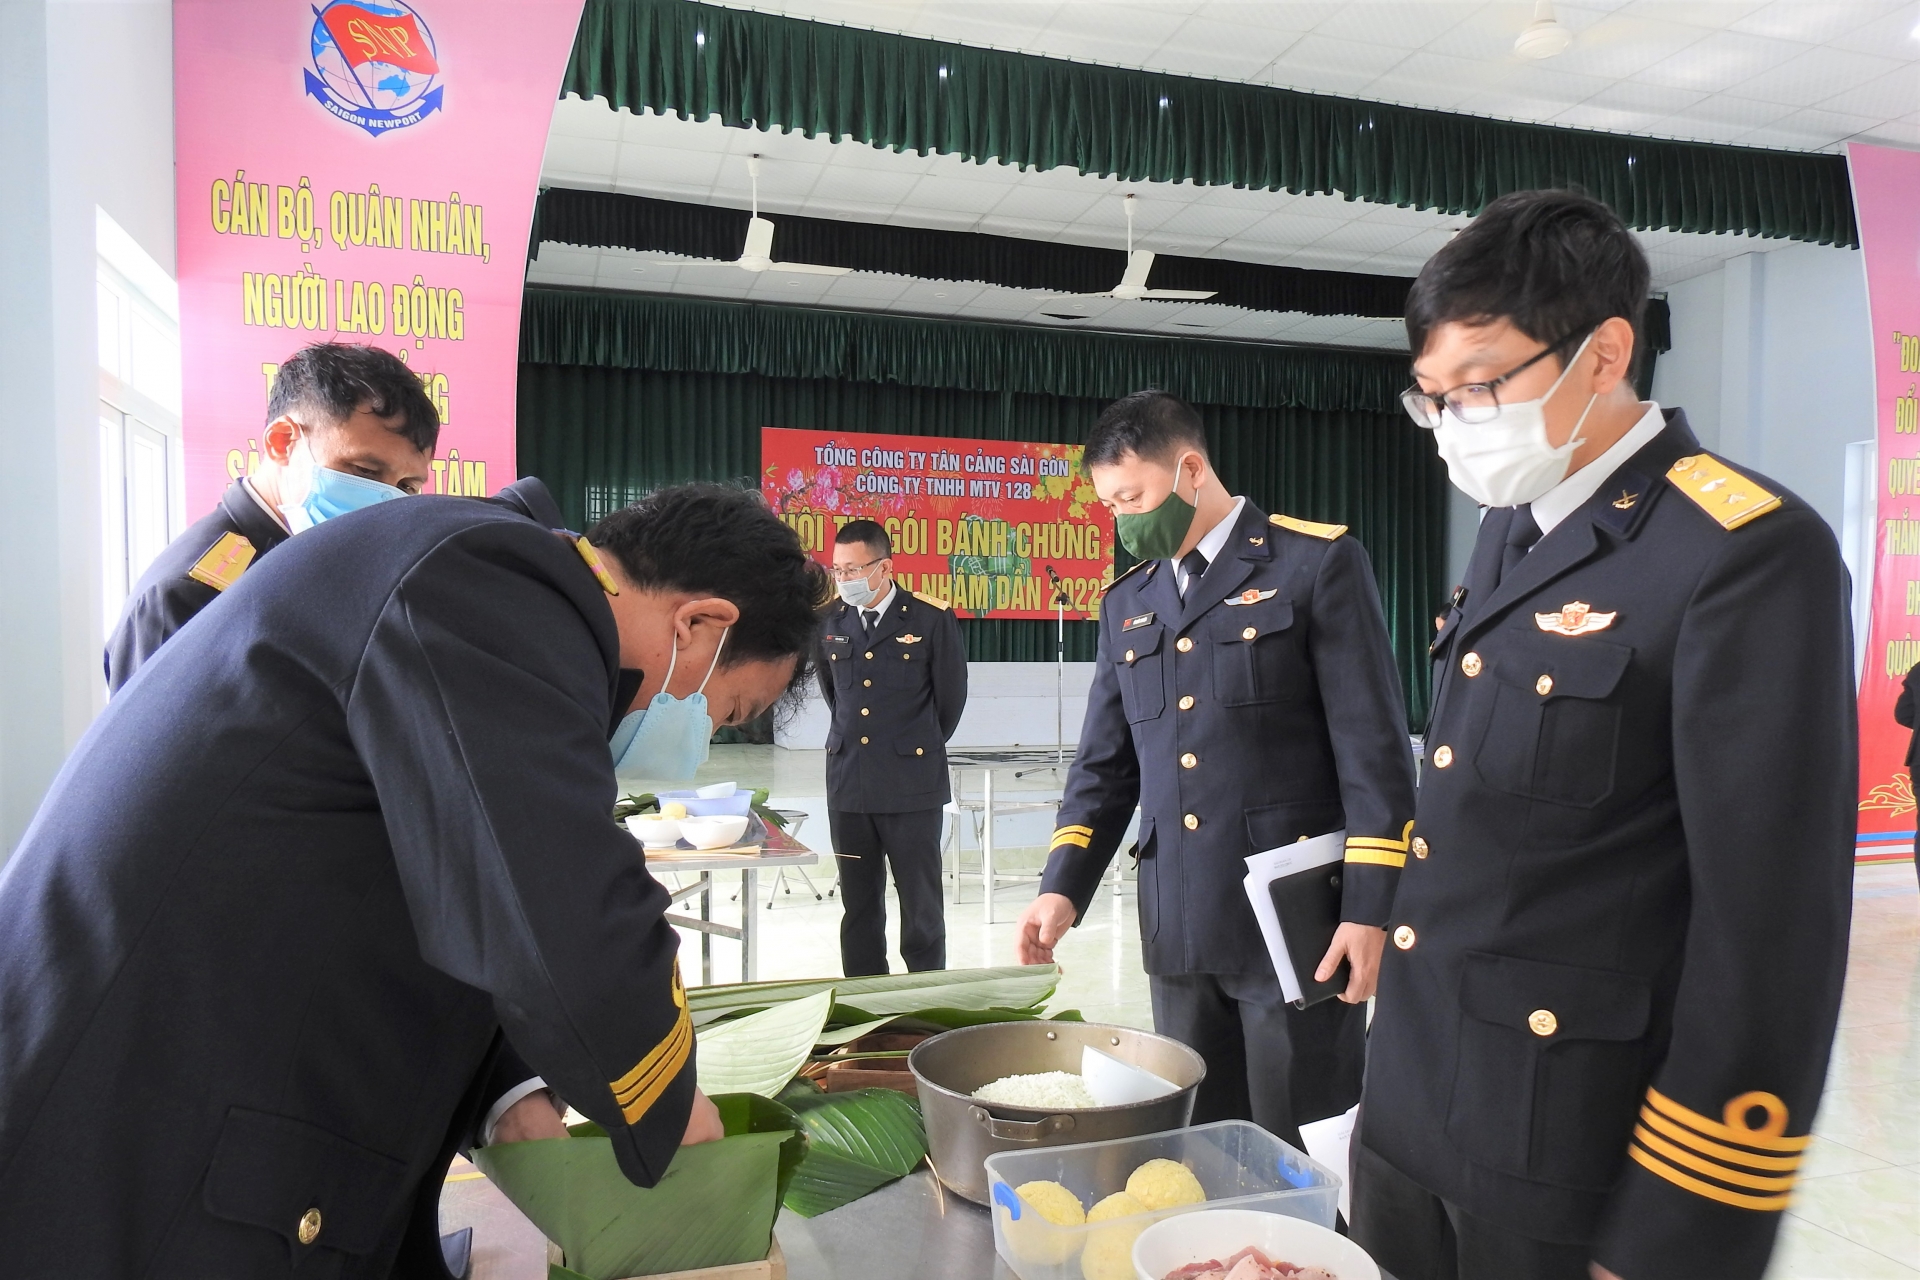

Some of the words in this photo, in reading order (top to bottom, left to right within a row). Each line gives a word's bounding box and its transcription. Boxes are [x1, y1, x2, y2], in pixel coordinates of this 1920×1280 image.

[347, 17, 418, 61] SNP
[324, 99, 366, 126] SAIGON
[368, 111, 422, 128] NEWPORT
[211, 169, 271, 238] CÁN
[277, 176, 323, 253] BỘ,
[330, 184, 403, 251] QUÂN
[410, 192, 491, 264] NHÂN,
[242, 263, 329, 331] NGƯỜI
[335, 279, 386, 336] LAO
[392, 275, 465, 350] ĐỘNG
[814, 440, 857, 467] TỔNG
[861, 445, 904, 470] CÔNG
[908, 452, 927, 471] TY
[930, 449, 960, 472] TÂN
[964, 448, 1006, 474] CẢNG
[1010, 454, 1035, 476] SÀI
[1039, 454, 1070, 477] GÒN
[855, 469, 899, 494] CÔNG
[903, 476, 921, 495] TY
[925, 477, 965, 497] TNHH
[969, 479, 1001, 498] MTV
[1005, 481, 1032, 500] 128
[884, 510, 928, 555] GÓI
[936, 511, 1007, 558] BÁNH
[1016, 520, 1101, 560] CHƯNG
[1885, 507, 1920, 556] THẮN
[921, 566, 989, 610] NHÂM
[996, 563, 1042, 611] DẦN
[1048, 577, 1101, 612] 2022
